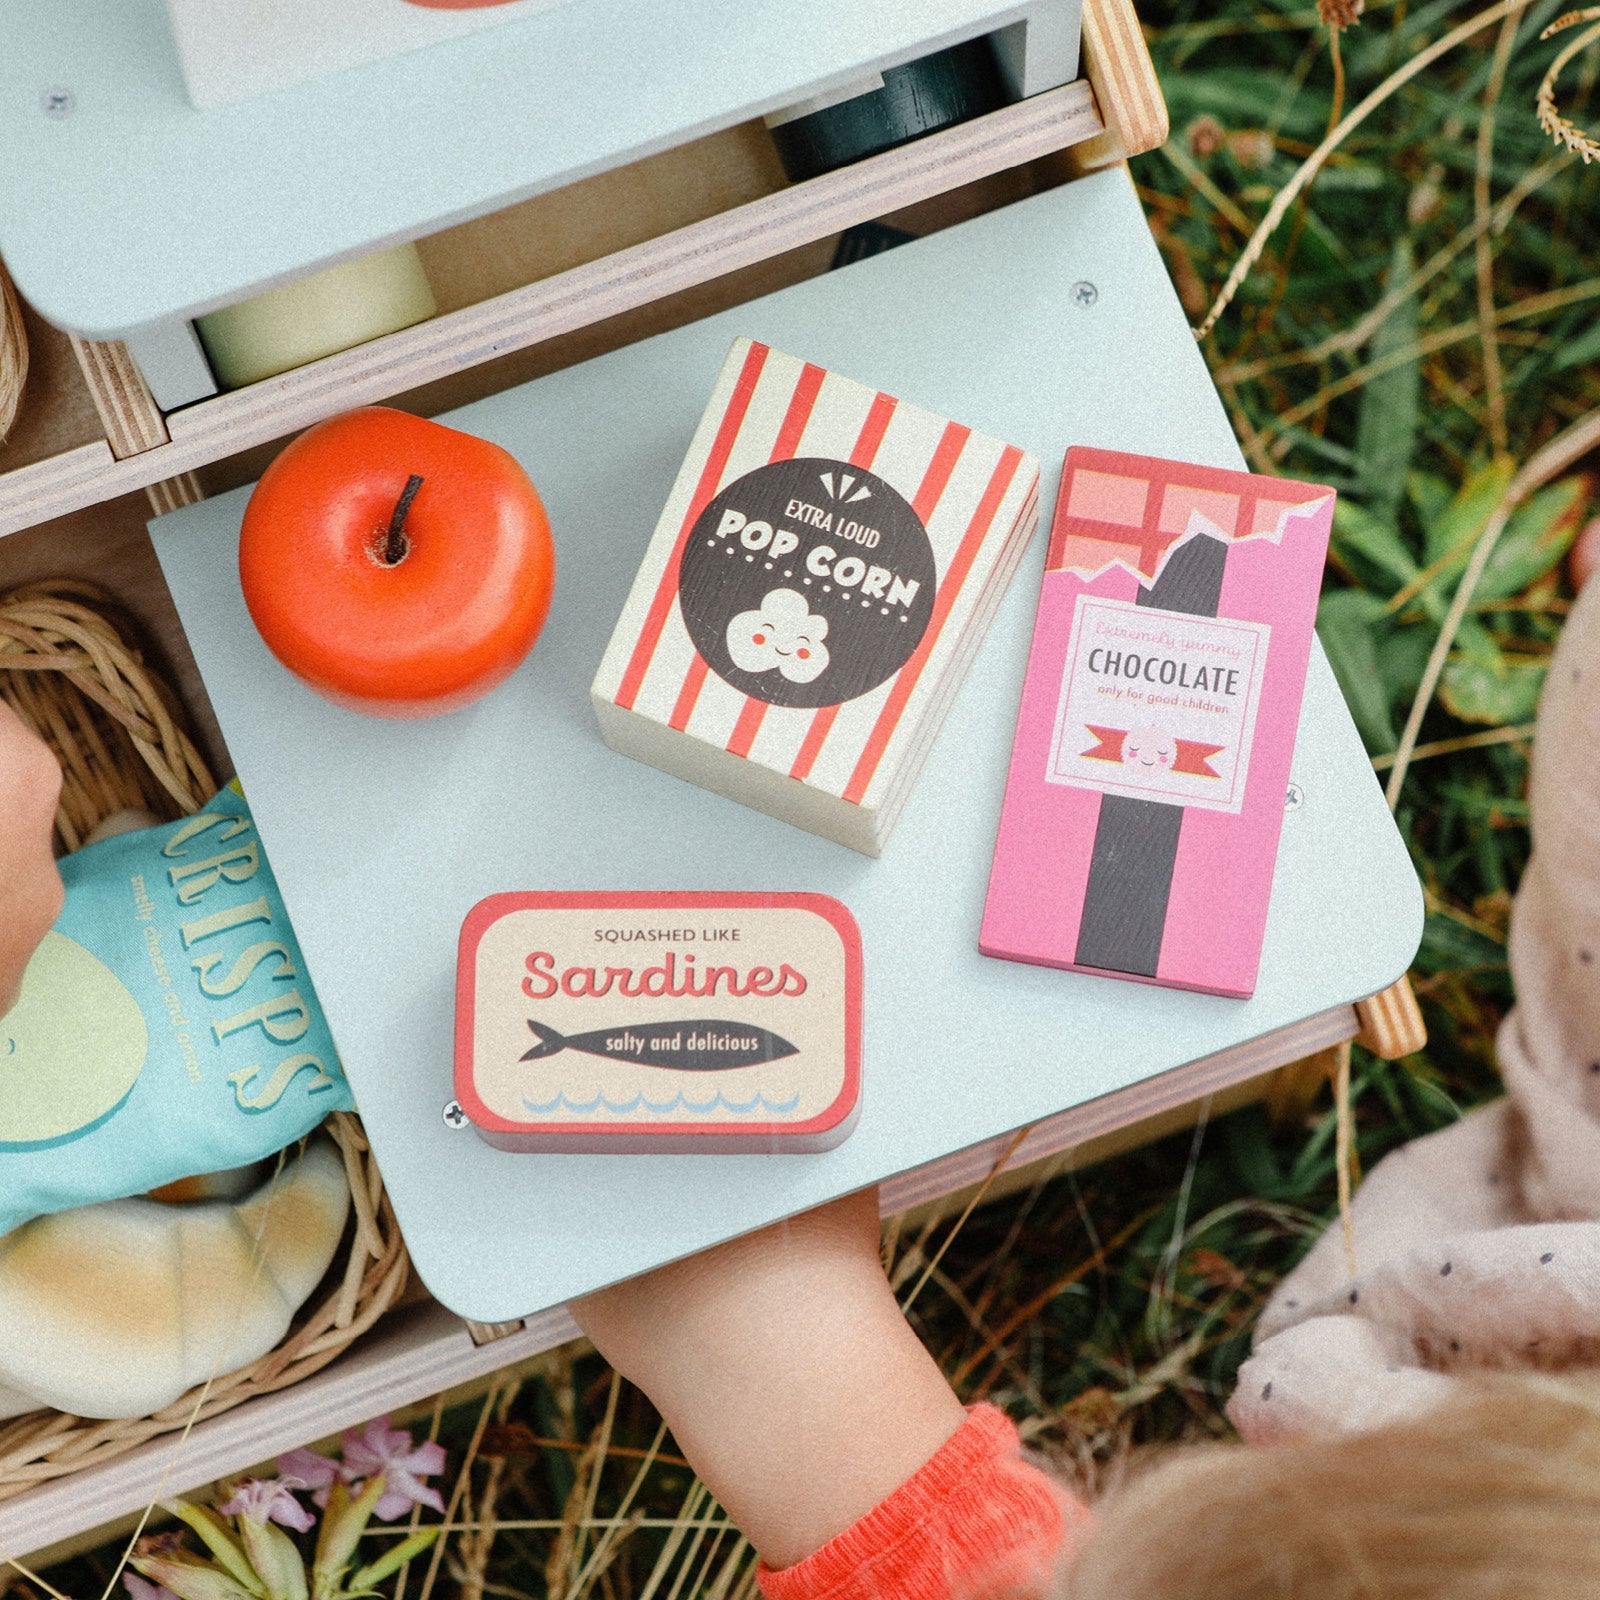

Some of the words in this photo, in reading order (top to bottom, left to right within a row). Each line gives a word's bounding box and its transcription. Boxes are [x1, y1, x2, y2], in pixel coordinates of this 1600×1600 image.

[785, 499, 834, 532] EXTRA
[835, 517, 881, 549] LOUD
[716, 508, 799, 559] POP
[806, 545, 920, 608] CORN
[1095, 621, 1175, 649] Extremely
[1178, 636, 1240, 660] yummy
[1088, 648, 1240, 696] CHOCOLATE
[1097, 685, 1122, 698] only
[1127, 687, 1143, 700] for
[1147, 694, 1178, 705] good
[1182, 698, 1229, 714] children
[143, 926, 172, 987] cheese
[594, 929, 696, 944] SQUASHED
[703, 929, 741, 942] LIKE
[162, 812, 334, 1115] CRISPS
[521, 951, 807, 1000] Sardines
[606, 1032, 645, 1055] salty
[650, 1033, 681, 1051] and
[687, 1033, 758, 1052] delicious
